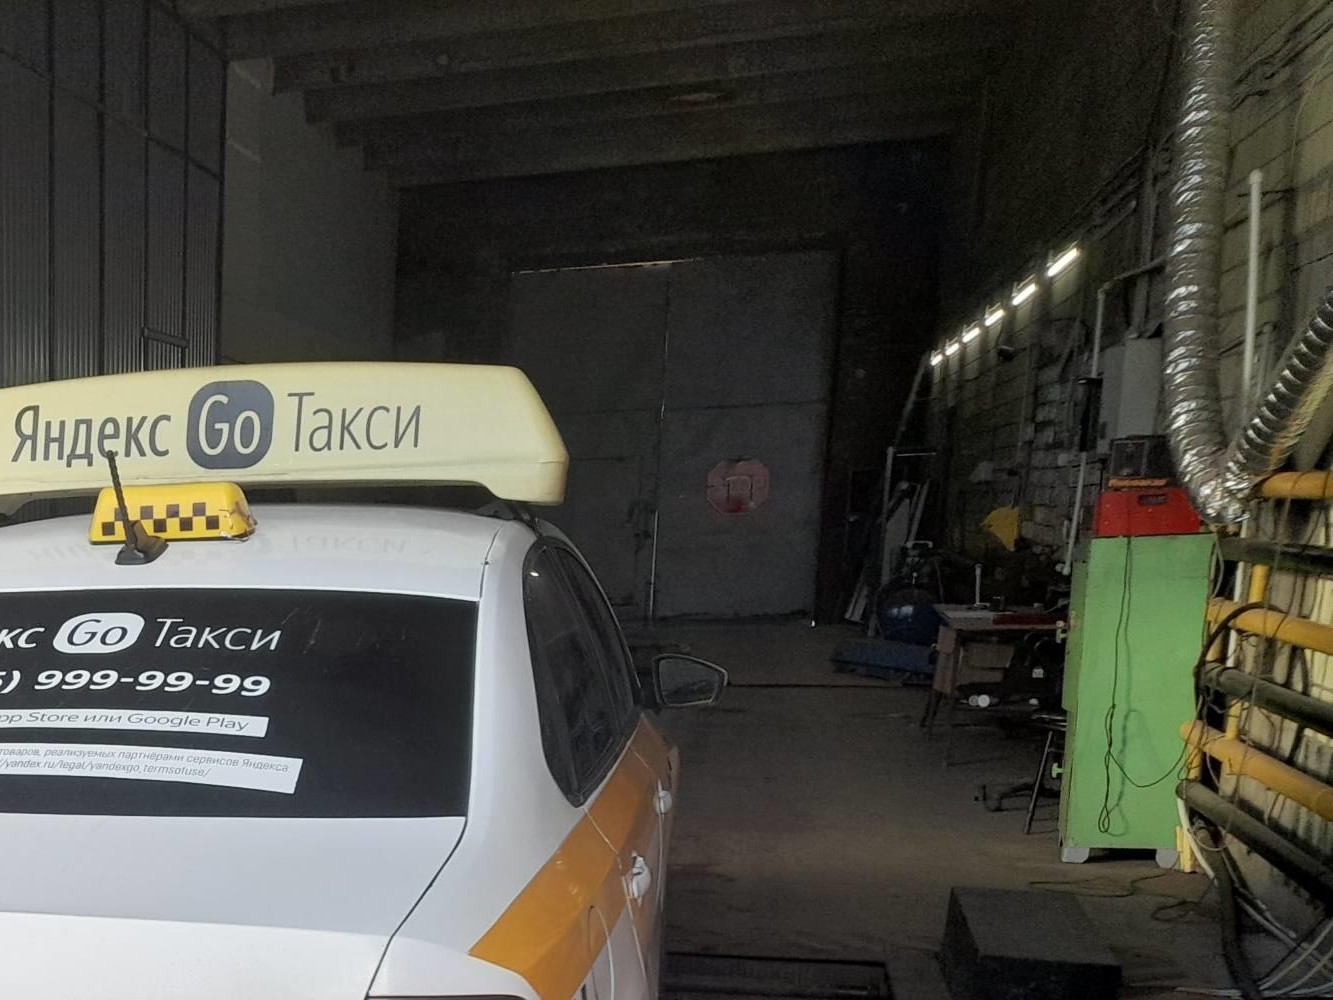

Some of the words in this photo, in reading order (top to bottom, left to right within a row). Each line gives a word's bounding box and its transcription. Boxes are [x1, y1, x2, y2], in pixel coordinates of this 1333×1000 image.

[11, 404, 171, 467] Яндекс
[197, 391, 261, 456] Go
[287, 392, 421, 451] Такси
[67, 620, 128, 646] Go
[154, 618, 282, 651] Такси
[34, 670, 271, 696] 999-99-99
[26, 712, 79, 723] Store
[83, 713, 122, 723] или
[127, 713, 200, 727] Google
[206, 715, 250, 731] Play
[43, 749, 115, 759] реализуемых
[186, 755, 238, 766] сервисов
